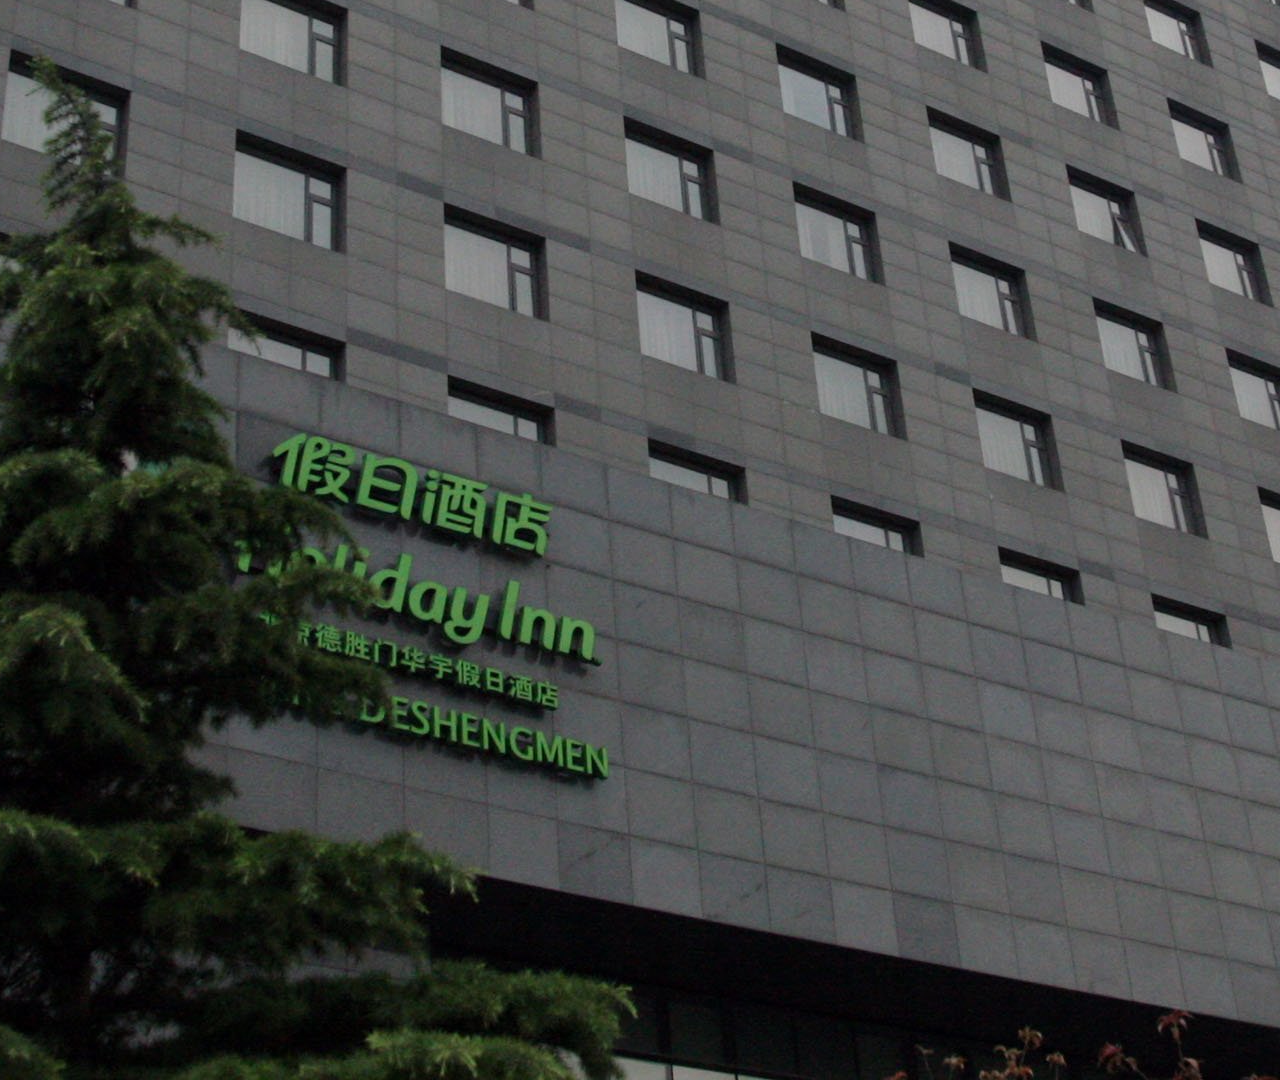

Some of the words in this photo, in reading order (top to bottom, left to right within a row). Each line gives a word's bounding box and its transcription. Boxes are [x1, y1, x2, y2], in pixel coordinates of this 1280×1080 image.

[272, 432, 554, 556] 假日酒店
[498, 578, 598, 662] Inn
